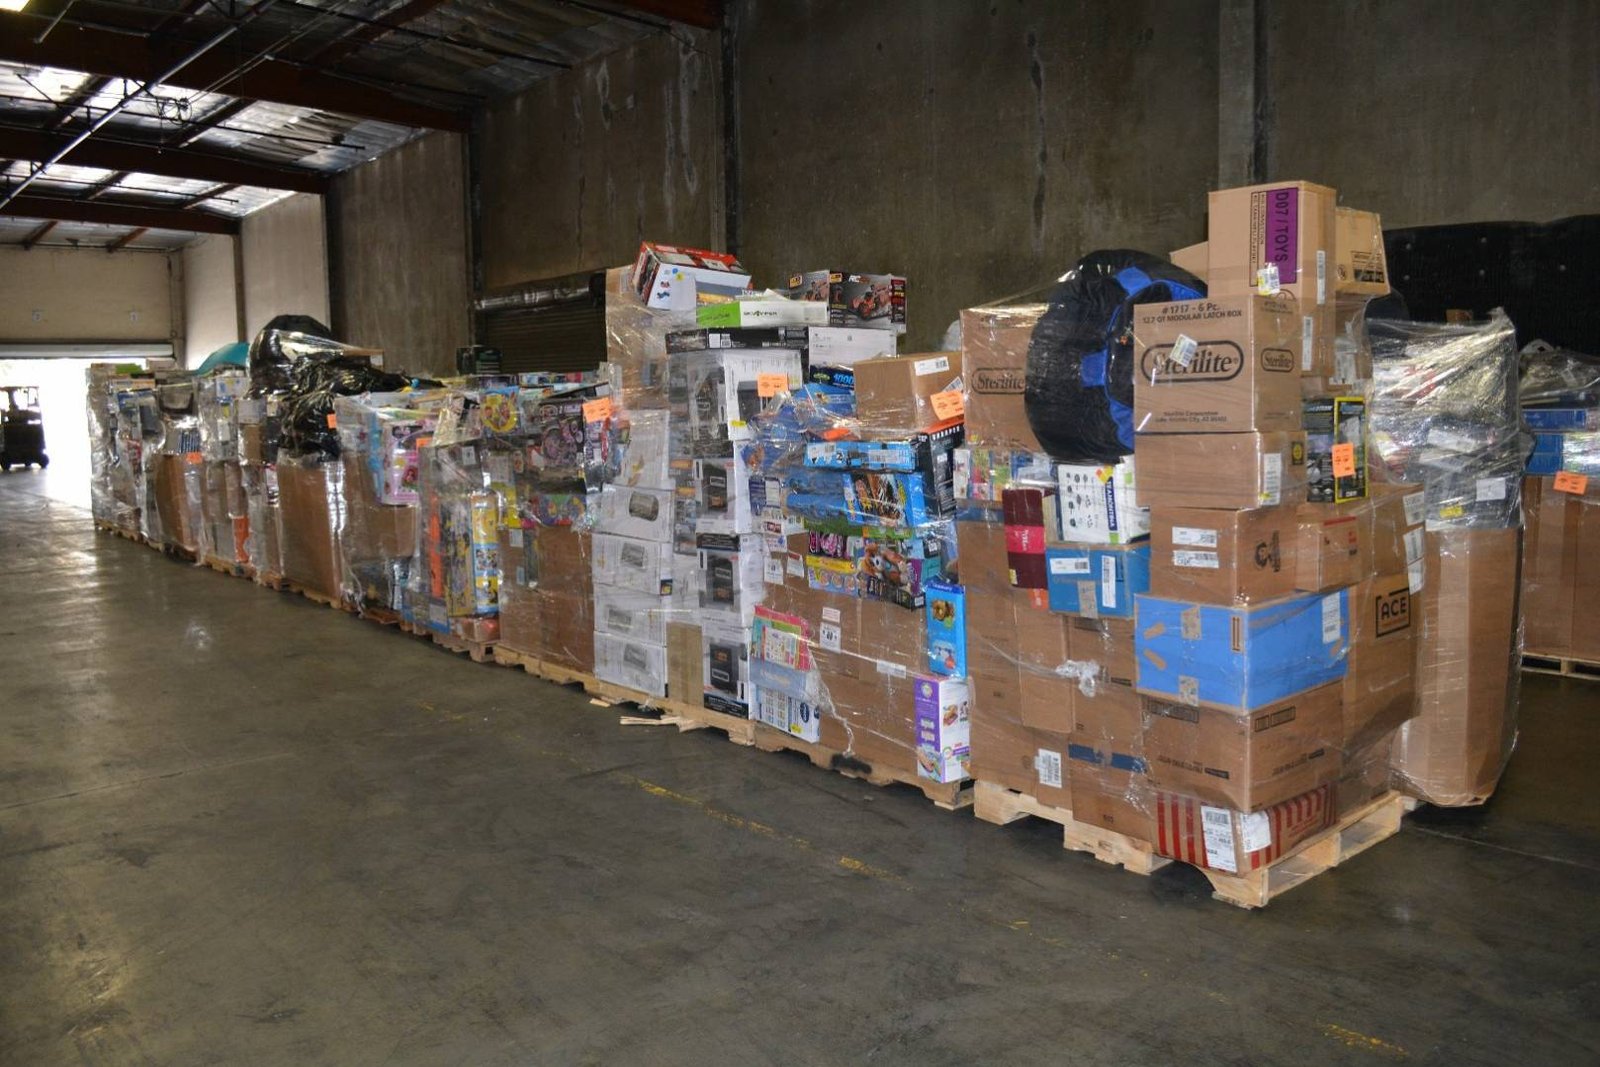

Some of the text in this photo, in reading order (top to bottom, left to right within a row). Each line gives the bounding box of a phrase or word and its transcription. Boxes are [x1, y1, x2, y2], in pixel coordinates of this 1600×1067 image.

[1275, 191, 1289, 216] D07
[1275, 226, 1289, 262] TOYS
[1381, 596, 1407, 619] ACE
